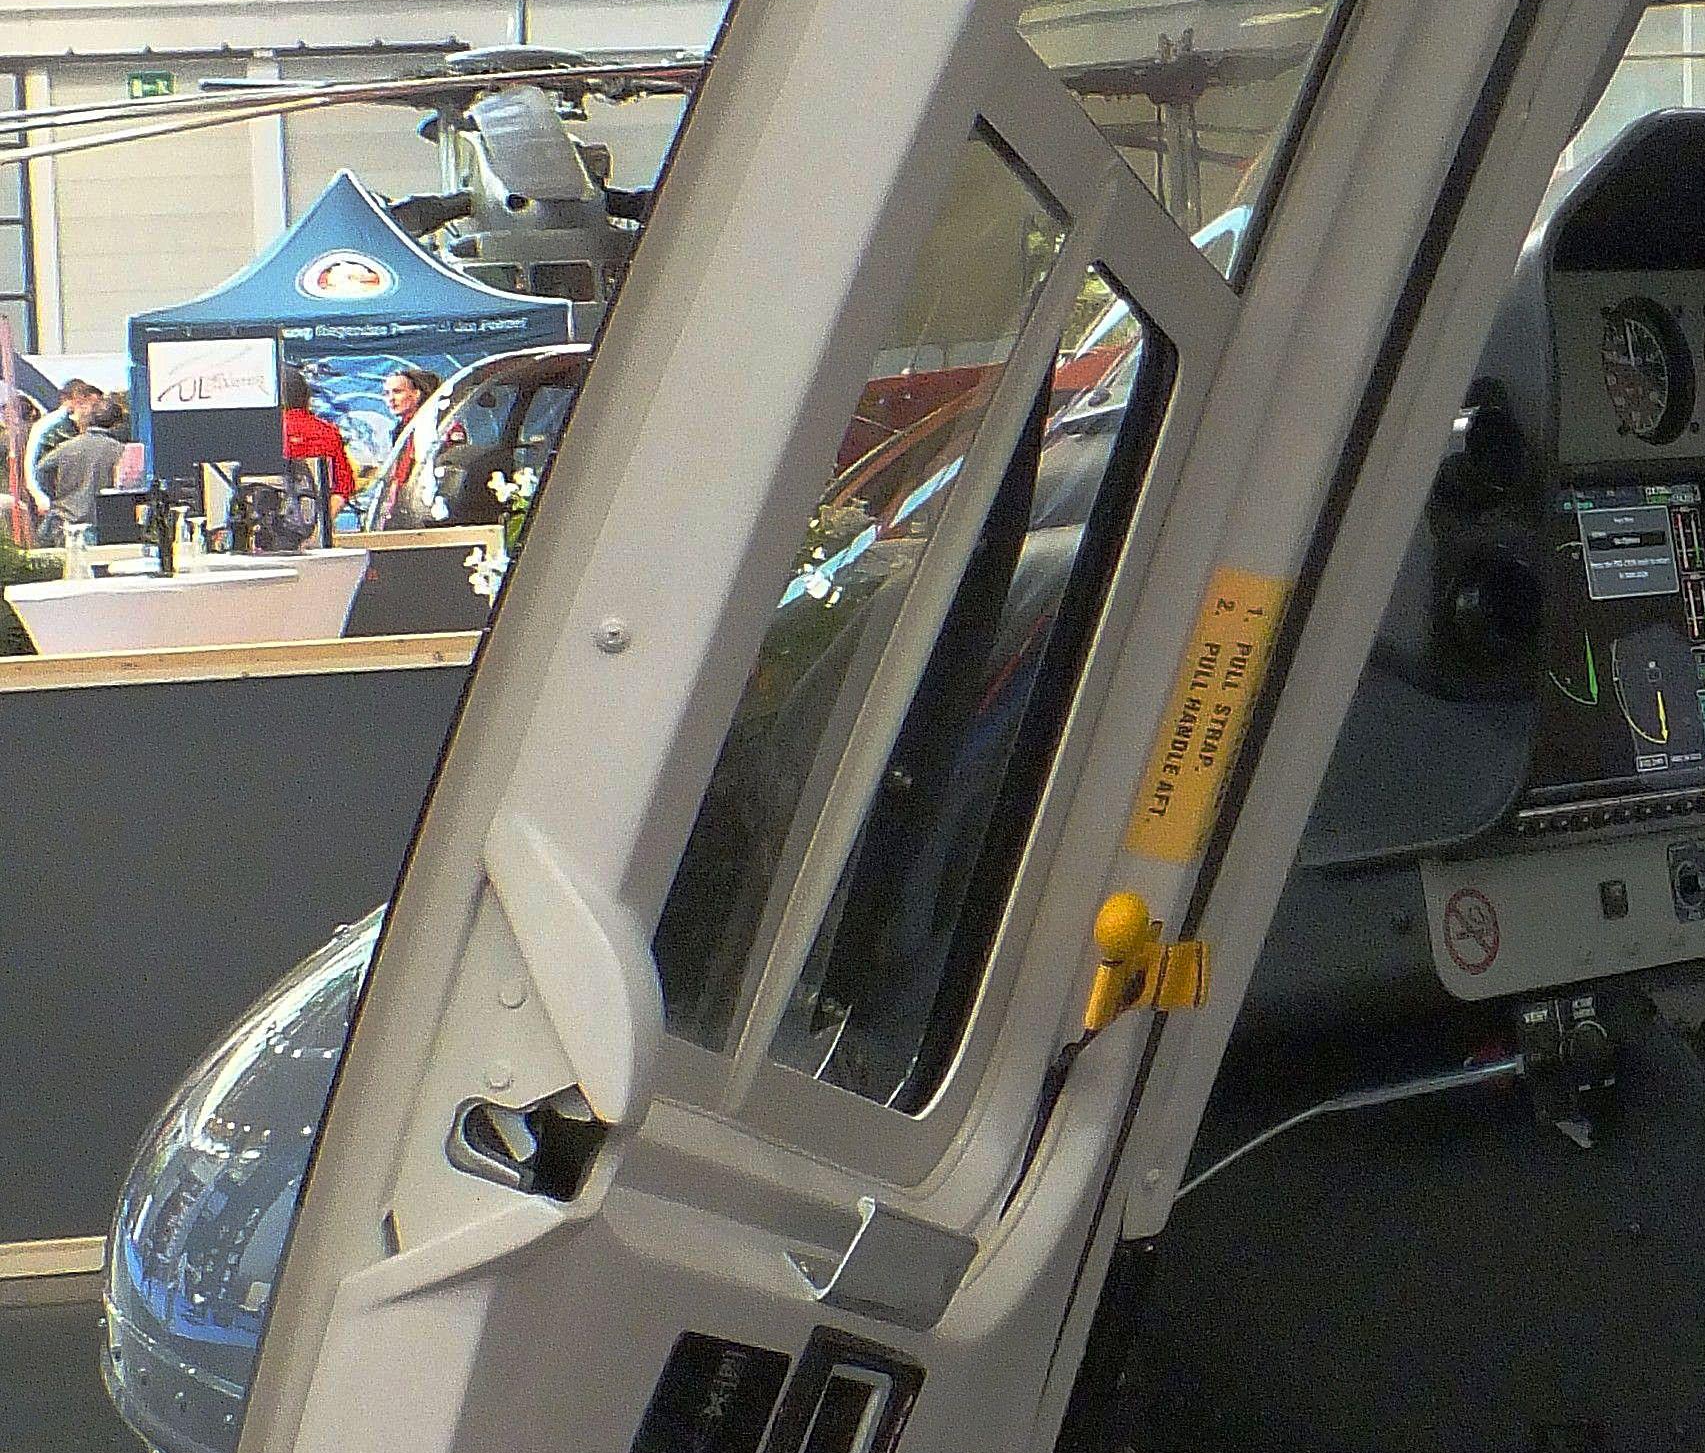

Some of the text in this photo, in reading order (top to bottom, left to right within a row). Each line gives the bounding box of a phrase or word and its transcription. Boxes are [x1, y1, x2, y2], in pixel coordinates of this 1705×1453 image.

[1215, 598, 1236, 616] 2.
[1190, 642, 1221, 691] PULL
[1195, 606, 1263, 772] 1. PULL STRAP.
[1163, 697, 1201, 776] HANDLE
